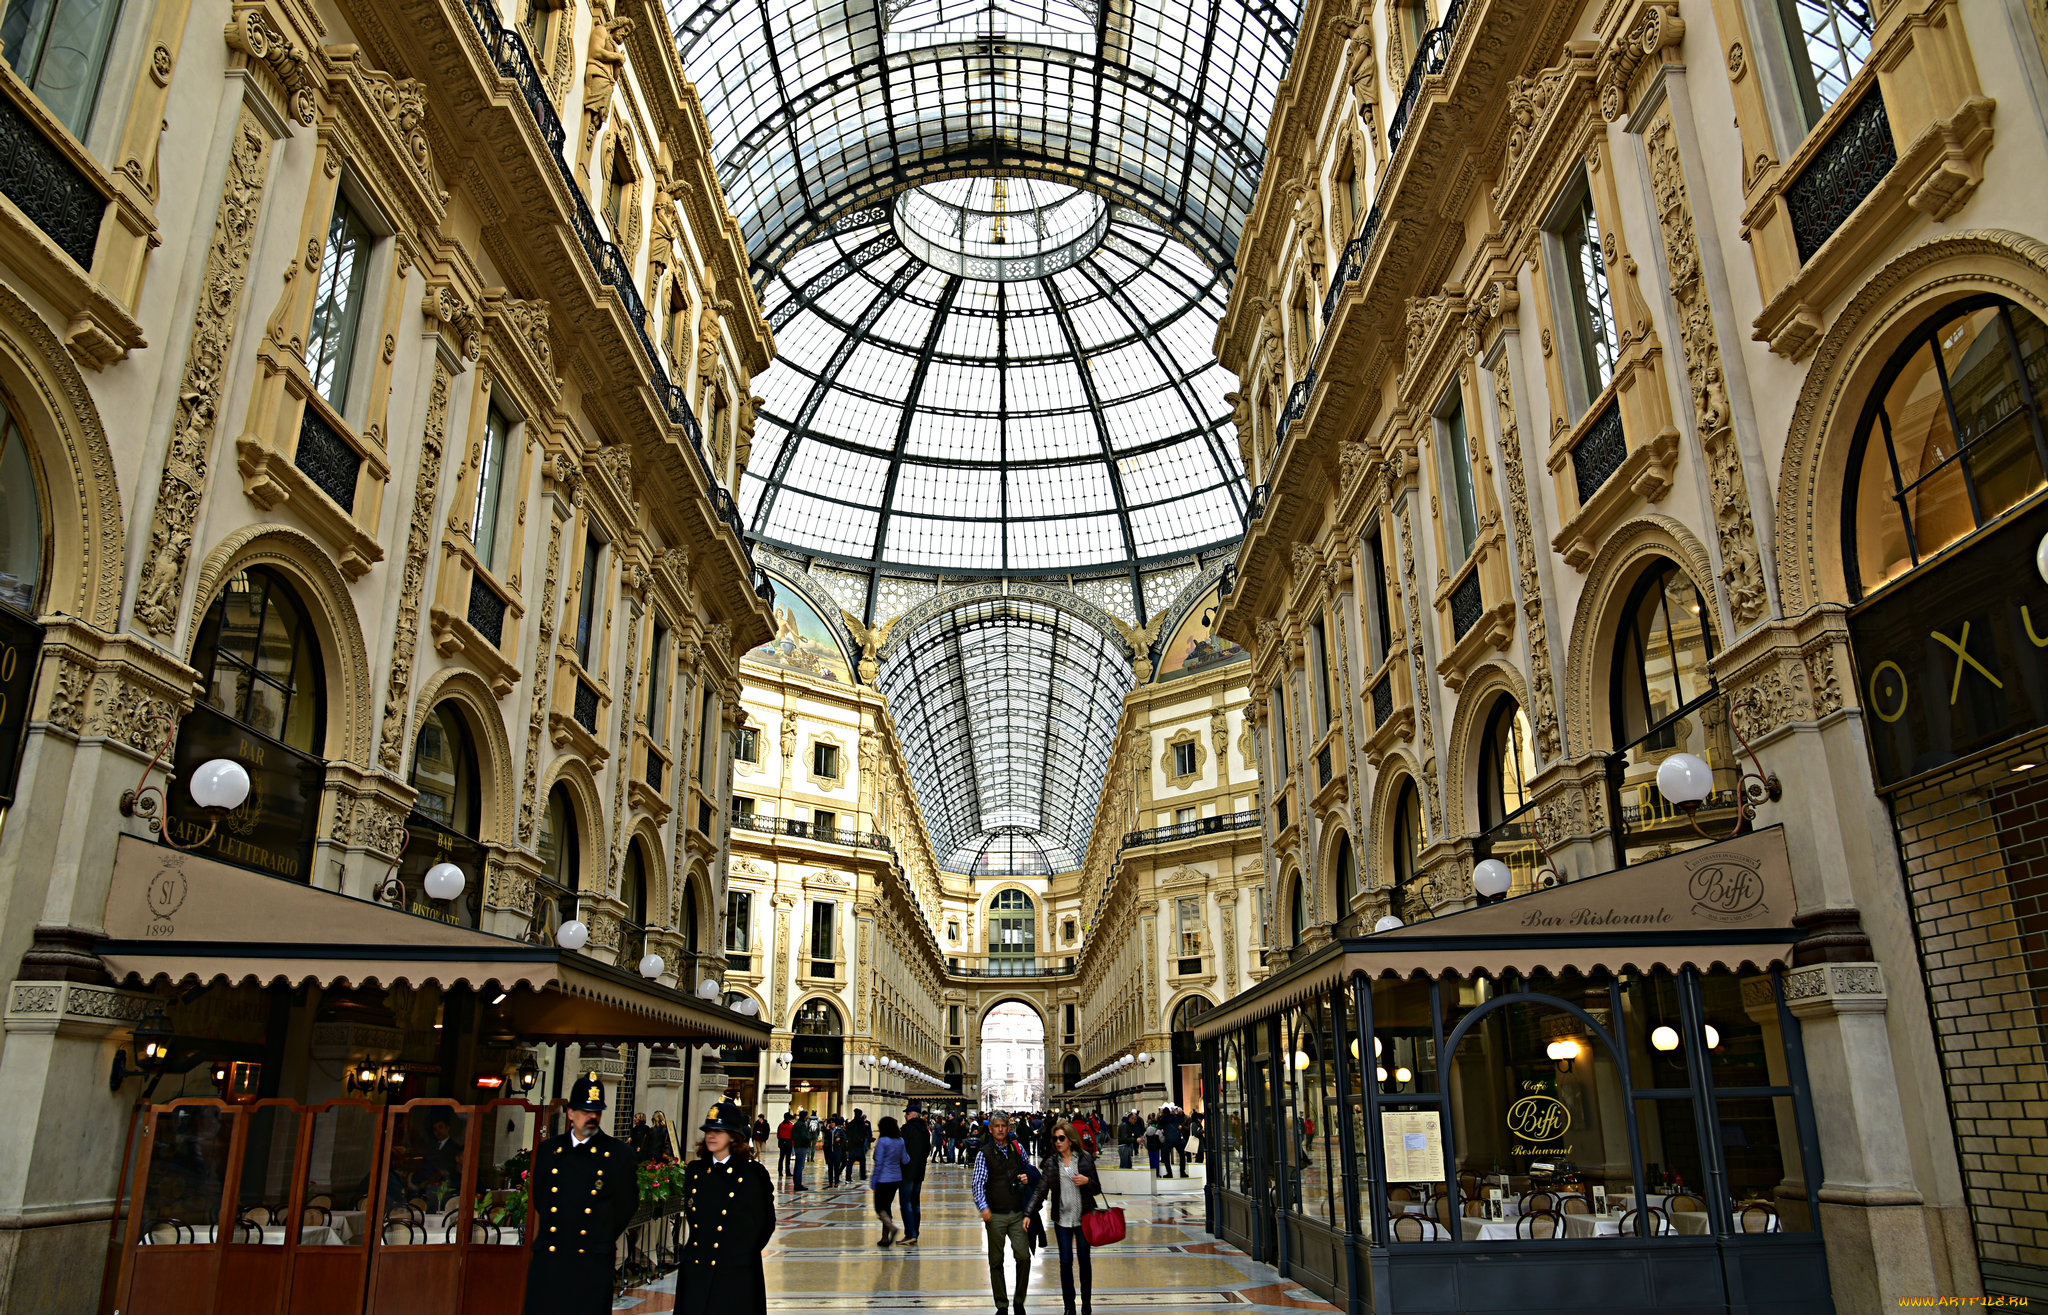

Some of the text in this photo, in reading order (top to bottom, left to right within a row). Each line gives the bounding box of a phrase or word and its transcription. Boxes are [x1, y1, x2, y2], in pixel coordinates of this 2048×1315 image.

[239, 739, 265, 766] BAR
[437, 832, 453, 852] BAR
[218, 833, 299, 877] LETTERARIO
[160, 880, 175, 905] SI
[1695, 866, 1756, 910] Biffi
[1520, 907, 1674, 927] Bar Ristorante
[146, 924, 175, 937] 1899
[1522, 1080, 1548, 1094] Café
[1513, 1099, 1563, 1140] Biffi
[1511, 1144, 1573, 1156] Restaurant
